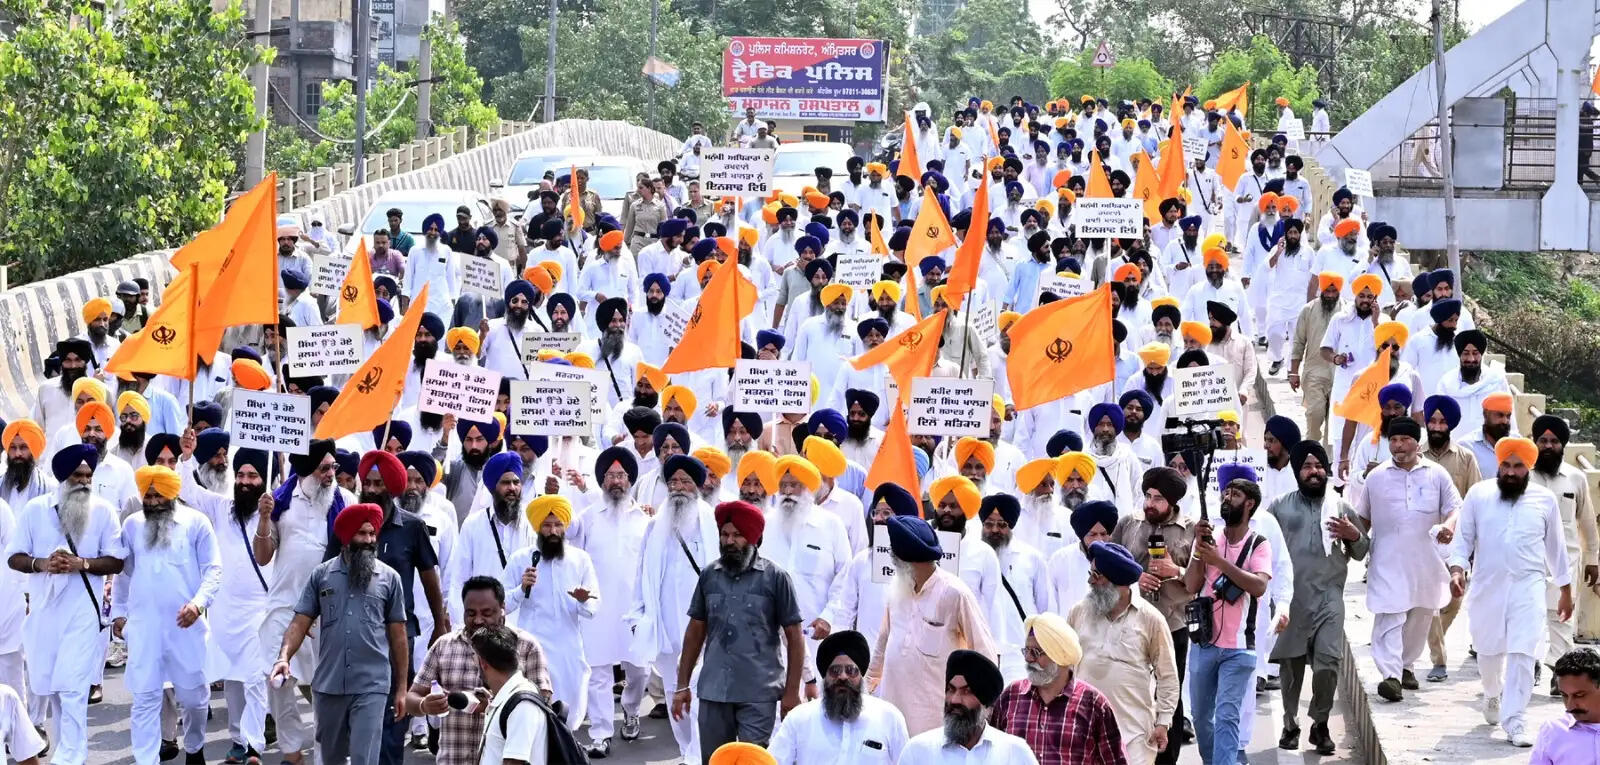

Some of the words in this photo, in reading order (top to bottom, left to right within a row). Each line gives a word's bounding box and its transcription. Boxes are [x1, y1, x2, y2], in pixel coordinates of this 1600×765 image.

[749, 42, 771, 56] ਪੁਲਿਸ
[805, 62, 872, 83] ਪੁਲਿਸ
[799, 100, 860, 111] ਹਸਪਤਾਲ
[261, 412, 270, 420] ਦੀ
[944, 419, 980, 428] ਸਤਿਕਾਰ
